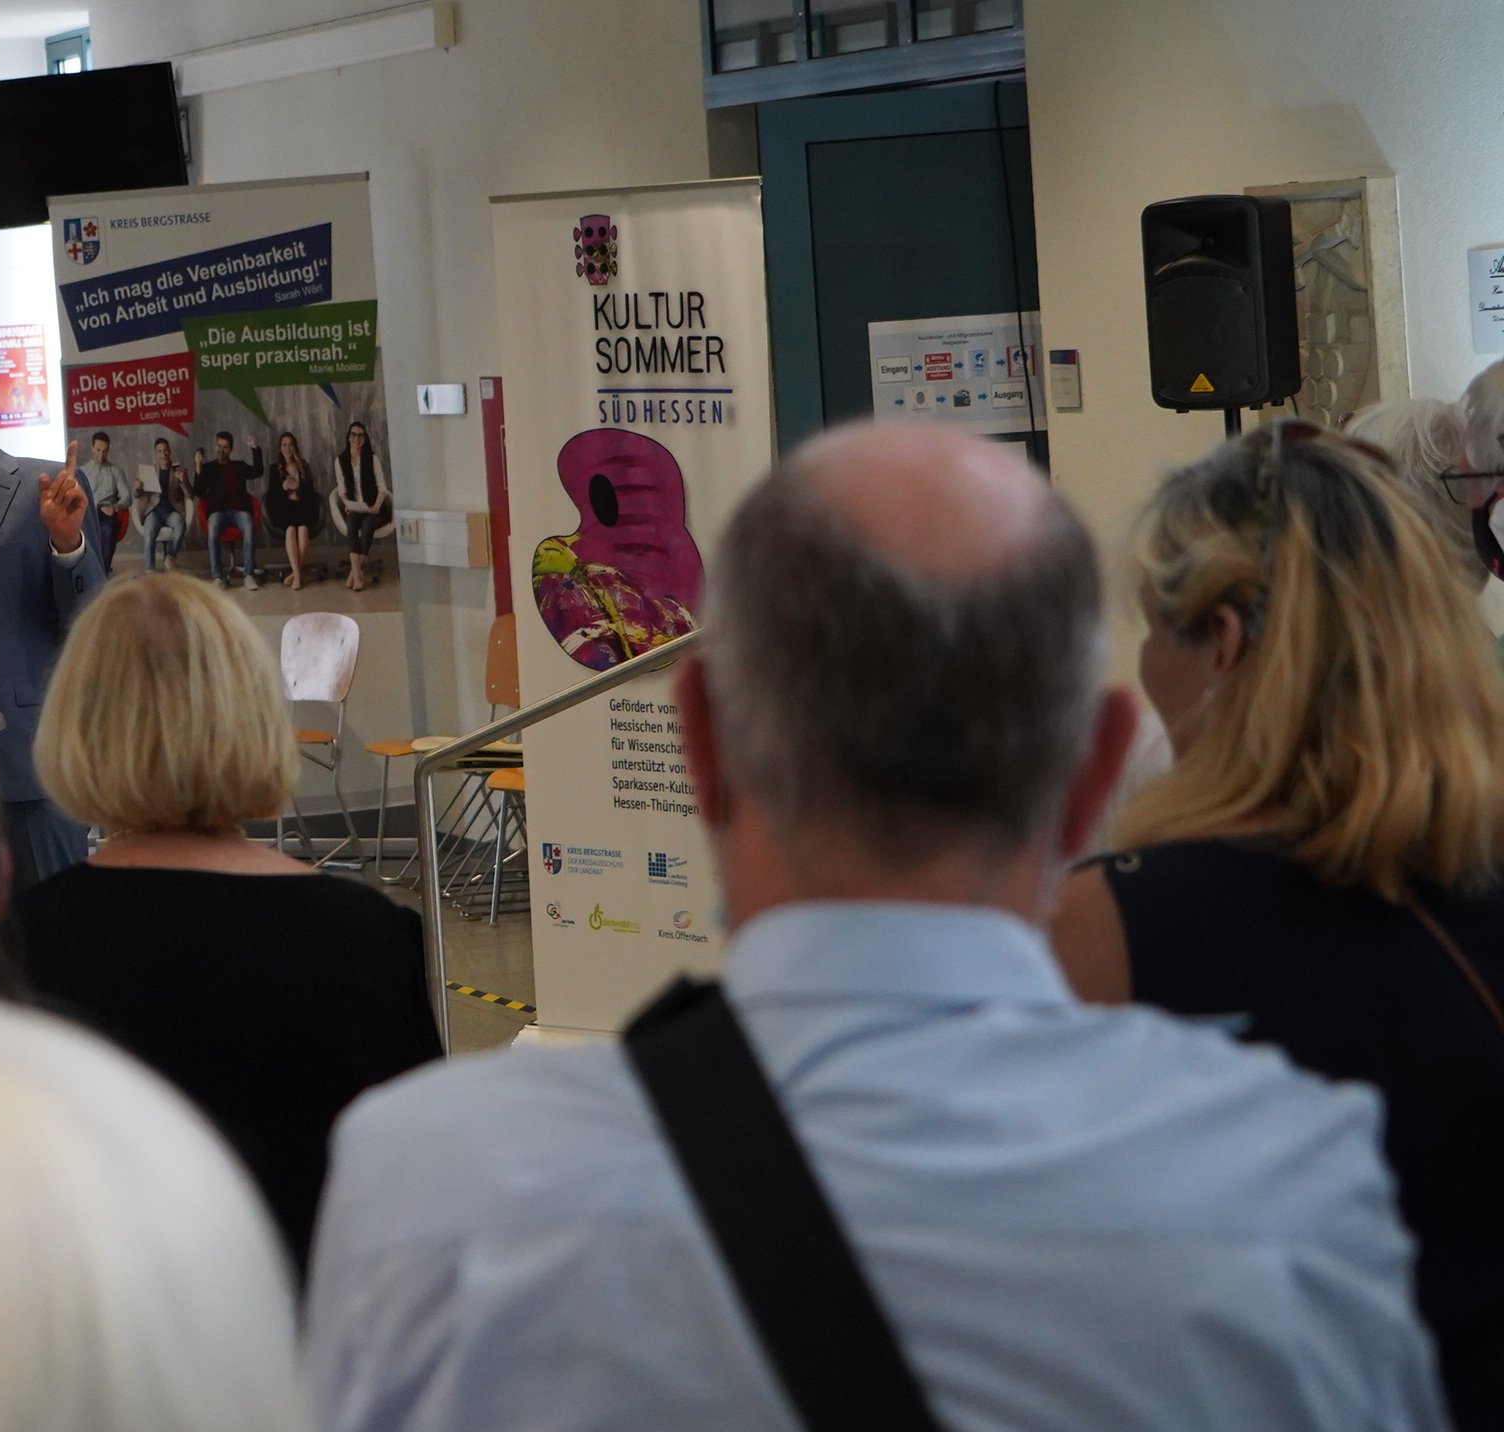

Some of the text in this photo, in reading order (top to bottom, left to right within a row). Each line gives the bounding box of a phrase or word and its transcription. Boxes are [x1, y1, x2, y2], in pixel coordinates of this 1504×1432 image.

[110, 212, 211, 230] KREIS BERGSTRASSE
[114, 281, 153, 301] mag
[157, 272, 183, 292] die
[186, 241, 307, 283] Vereinbarkeit
[274, 288, 301, 303] Sarah
[78, 309, 110, 331] von
[115, 297, 169, 323] Arbeit
[172, 289, 207, 310] und
[593, 291, 706, 330] KULTUR
[240, 320, 343, 345] Ausbildung
[347, 319, 371, 338] ist
[200, 351, 251, 371] super
[595, 335, 725, 374] SOMMER
[112, 367, 189, 388] Kollegen
[880, 364, 908, 376] Eingang
[73, 394, 110, 415] sind
[993, 388, 1024, 401] Ausgang
[599, 394, 723, 424] SÜDHESSEN
[609, 698, 678, 715] Gefördert vom
[610, 718, 663, 733] Hessischen
[611, 737, 625, 751] für
[612, 758, 666, 773] unterstützt
[668, 763, 687, 775] von
[613, 795, 700, 817] Hessen-Thüringen
[658, 928, 708, 943] Kreis Offenbach
